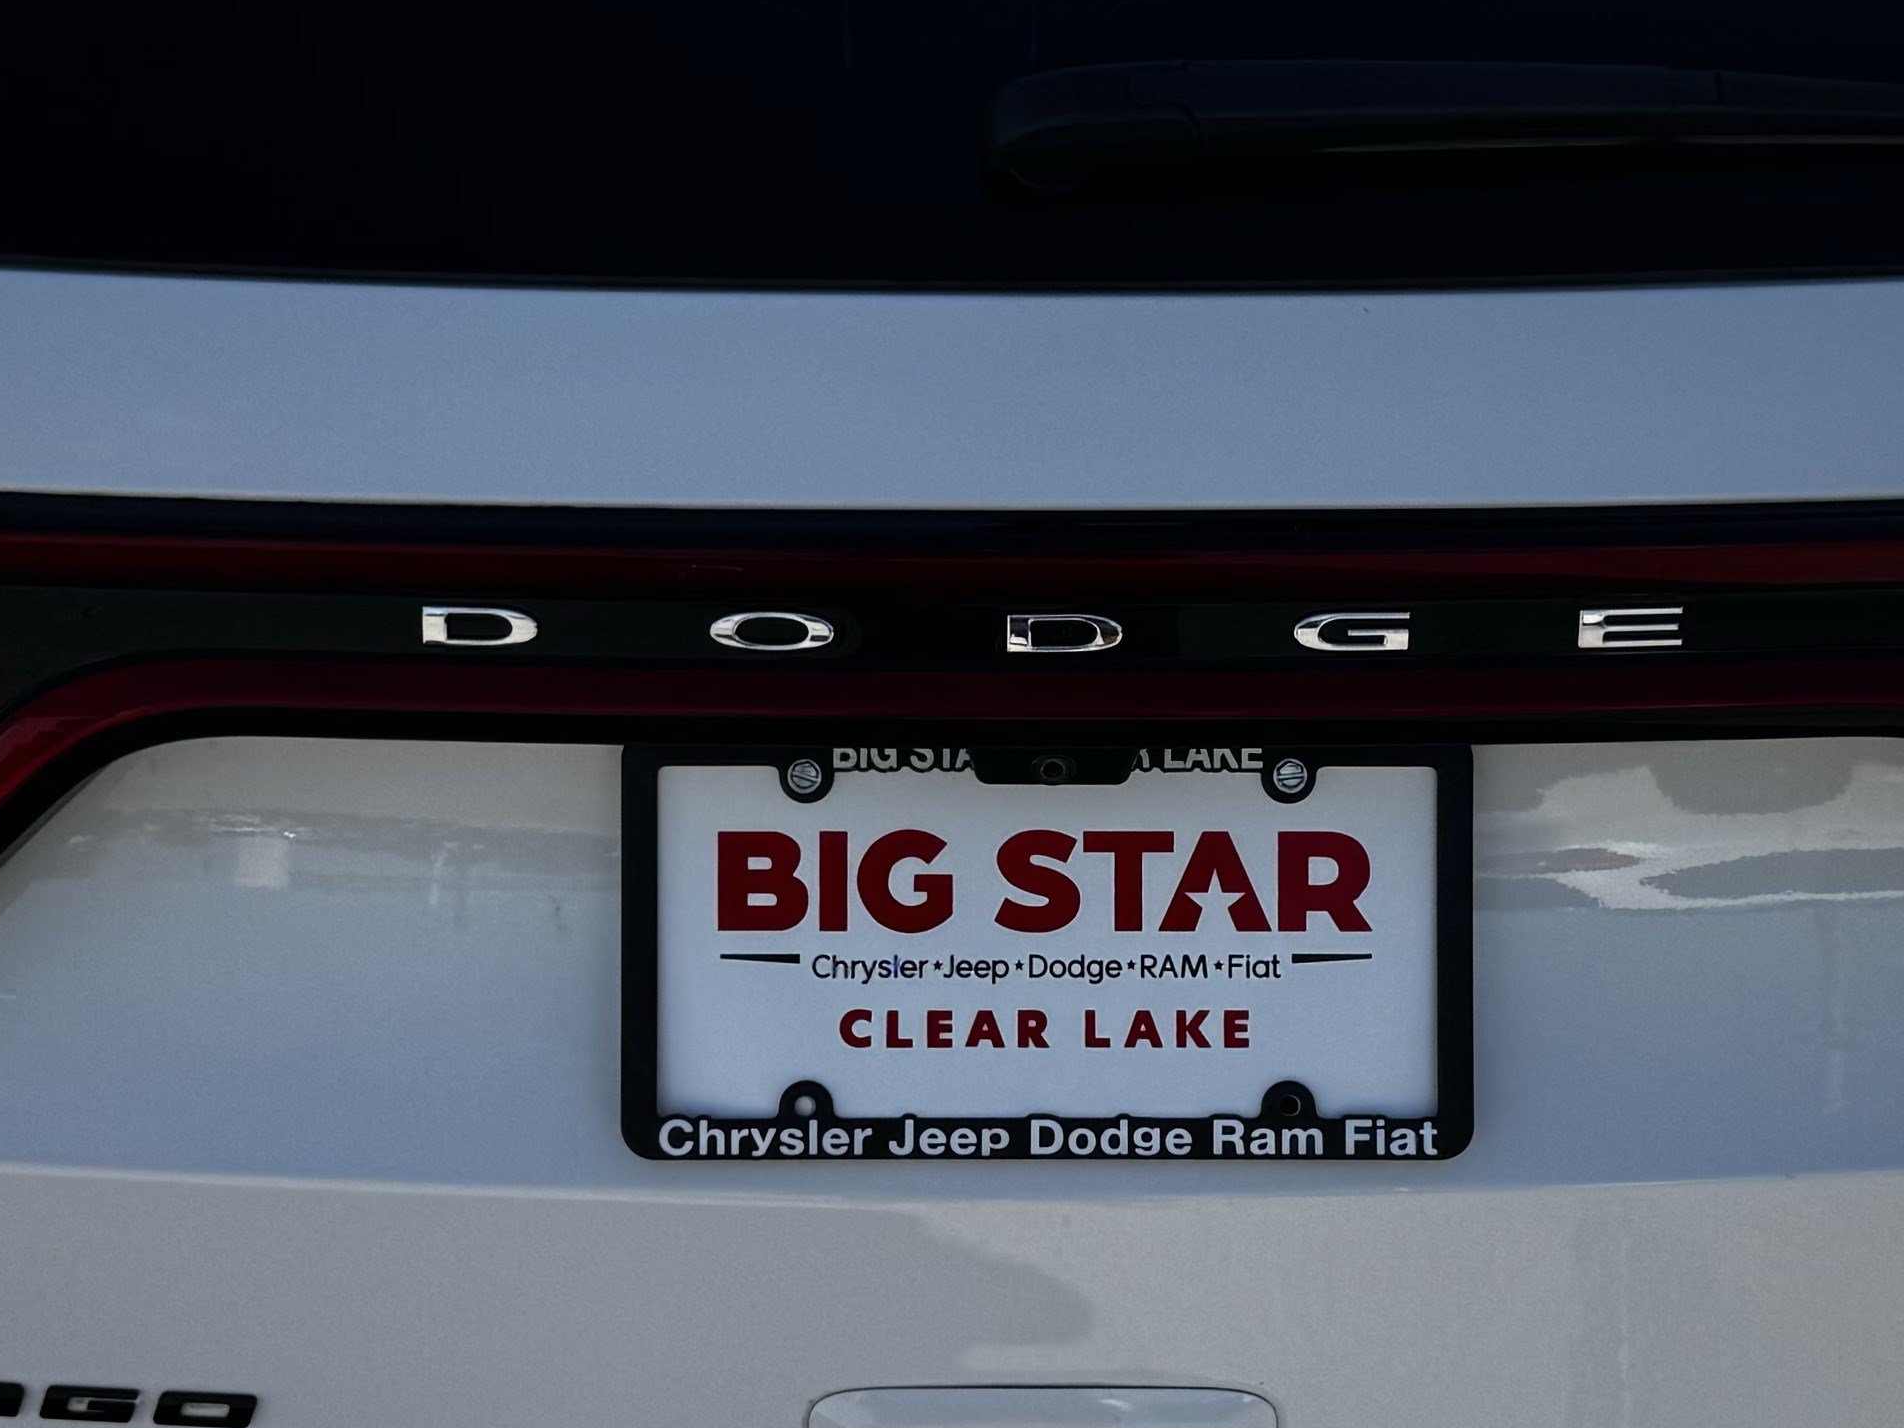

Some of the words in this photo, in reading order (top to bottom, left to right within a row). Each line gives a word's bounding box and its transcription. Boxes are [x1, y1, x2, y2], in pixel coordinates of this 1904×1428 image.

[422, 606, 1684, 653] DODGE
[718, 829, 954, 933] BIG
[994, 829, 1372, 933] STAR
[812, 954, 929, 985] Chrysler
[943, 954, 1010, 985] Jeep
[1028, 954, 1123, 985] Dodge
[1140, 954, 1208, 979] RAM
[1228, 954, 1282, 979] Fiat
[840, 1009, 1048, 1049] CLEAR
[1086, 1009, 1251, 1049] LAKE
[658, 1118, 873, 1157] Chrysler
[888, 1118, 1010, 1157] Jeep
[1030, 1118, 1193, 1157] Dodge
[1212, 1118, 1324, 1156] Ram
[1345, 1118, 1438, 1156] Fiat
